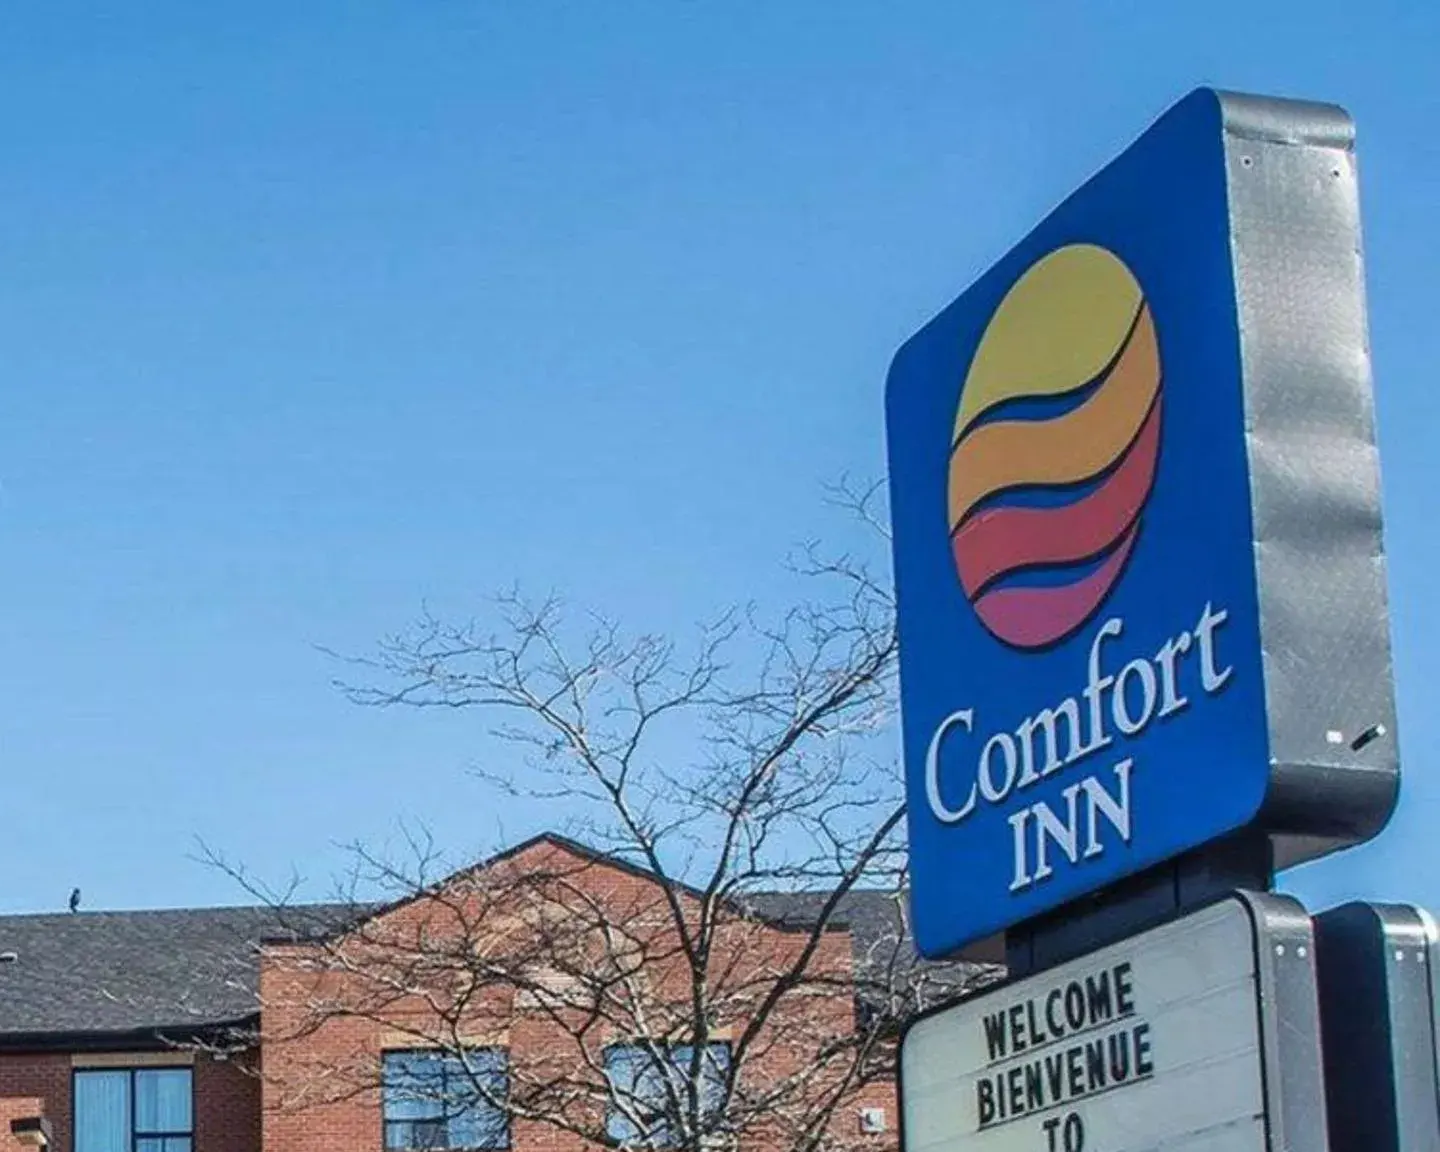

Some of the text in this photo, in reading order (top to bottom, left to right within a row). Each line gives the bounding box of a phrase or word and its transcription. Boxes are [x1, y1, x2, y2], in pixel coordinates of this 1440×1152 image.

[925, 600, 1233, 822] Comfort
[1008, 757, 1132, 890] INN
[983, 962, 1135, 1060] WELCOME
[977, 1023, 1154, 1124] BIENVENUE
